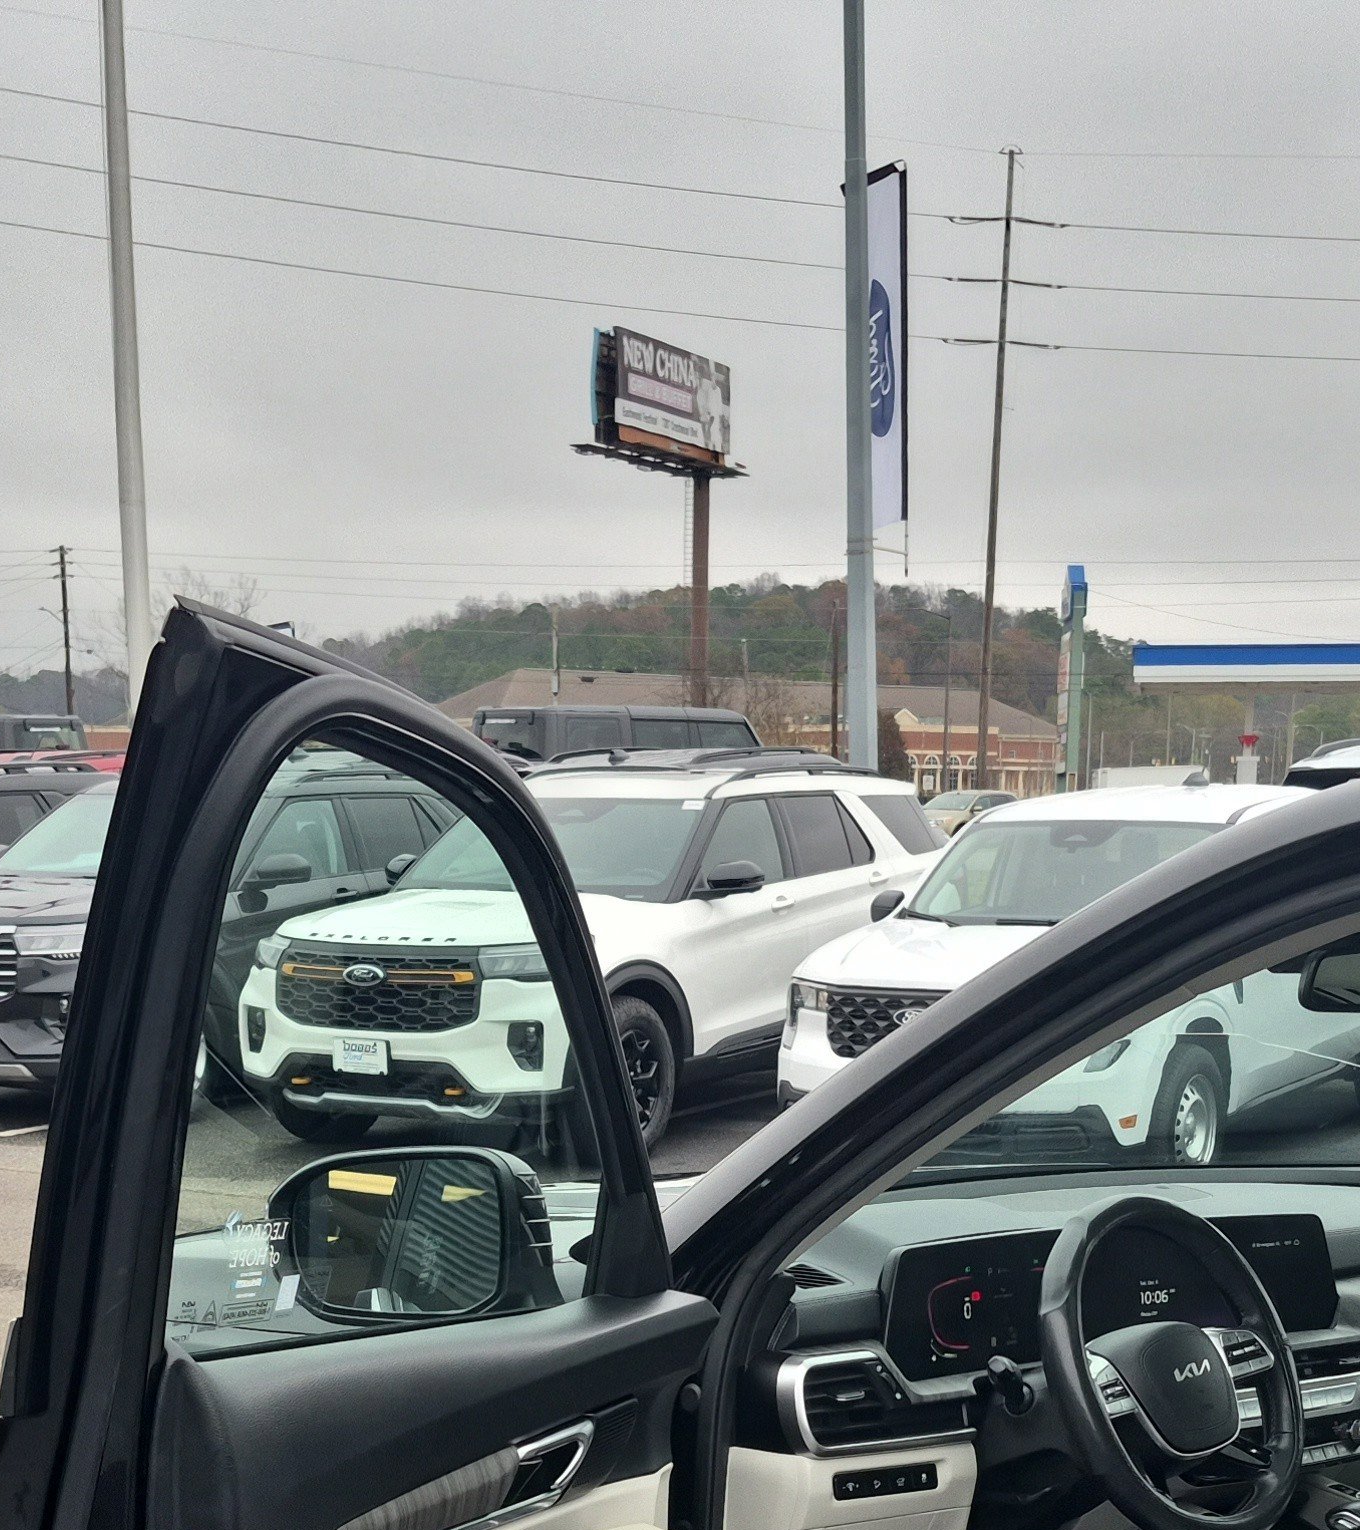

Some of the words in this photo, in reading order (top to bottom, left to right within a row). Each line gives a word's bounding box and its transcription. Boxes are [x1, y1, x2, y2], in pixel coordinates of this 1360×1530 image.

[623, 335, 654, 375] NEW
[656, 347, 698, 388] CHINA
[309, 932, 457, 942] EXPLORER
[1140, 1290, 1168, 1305] 10:06
